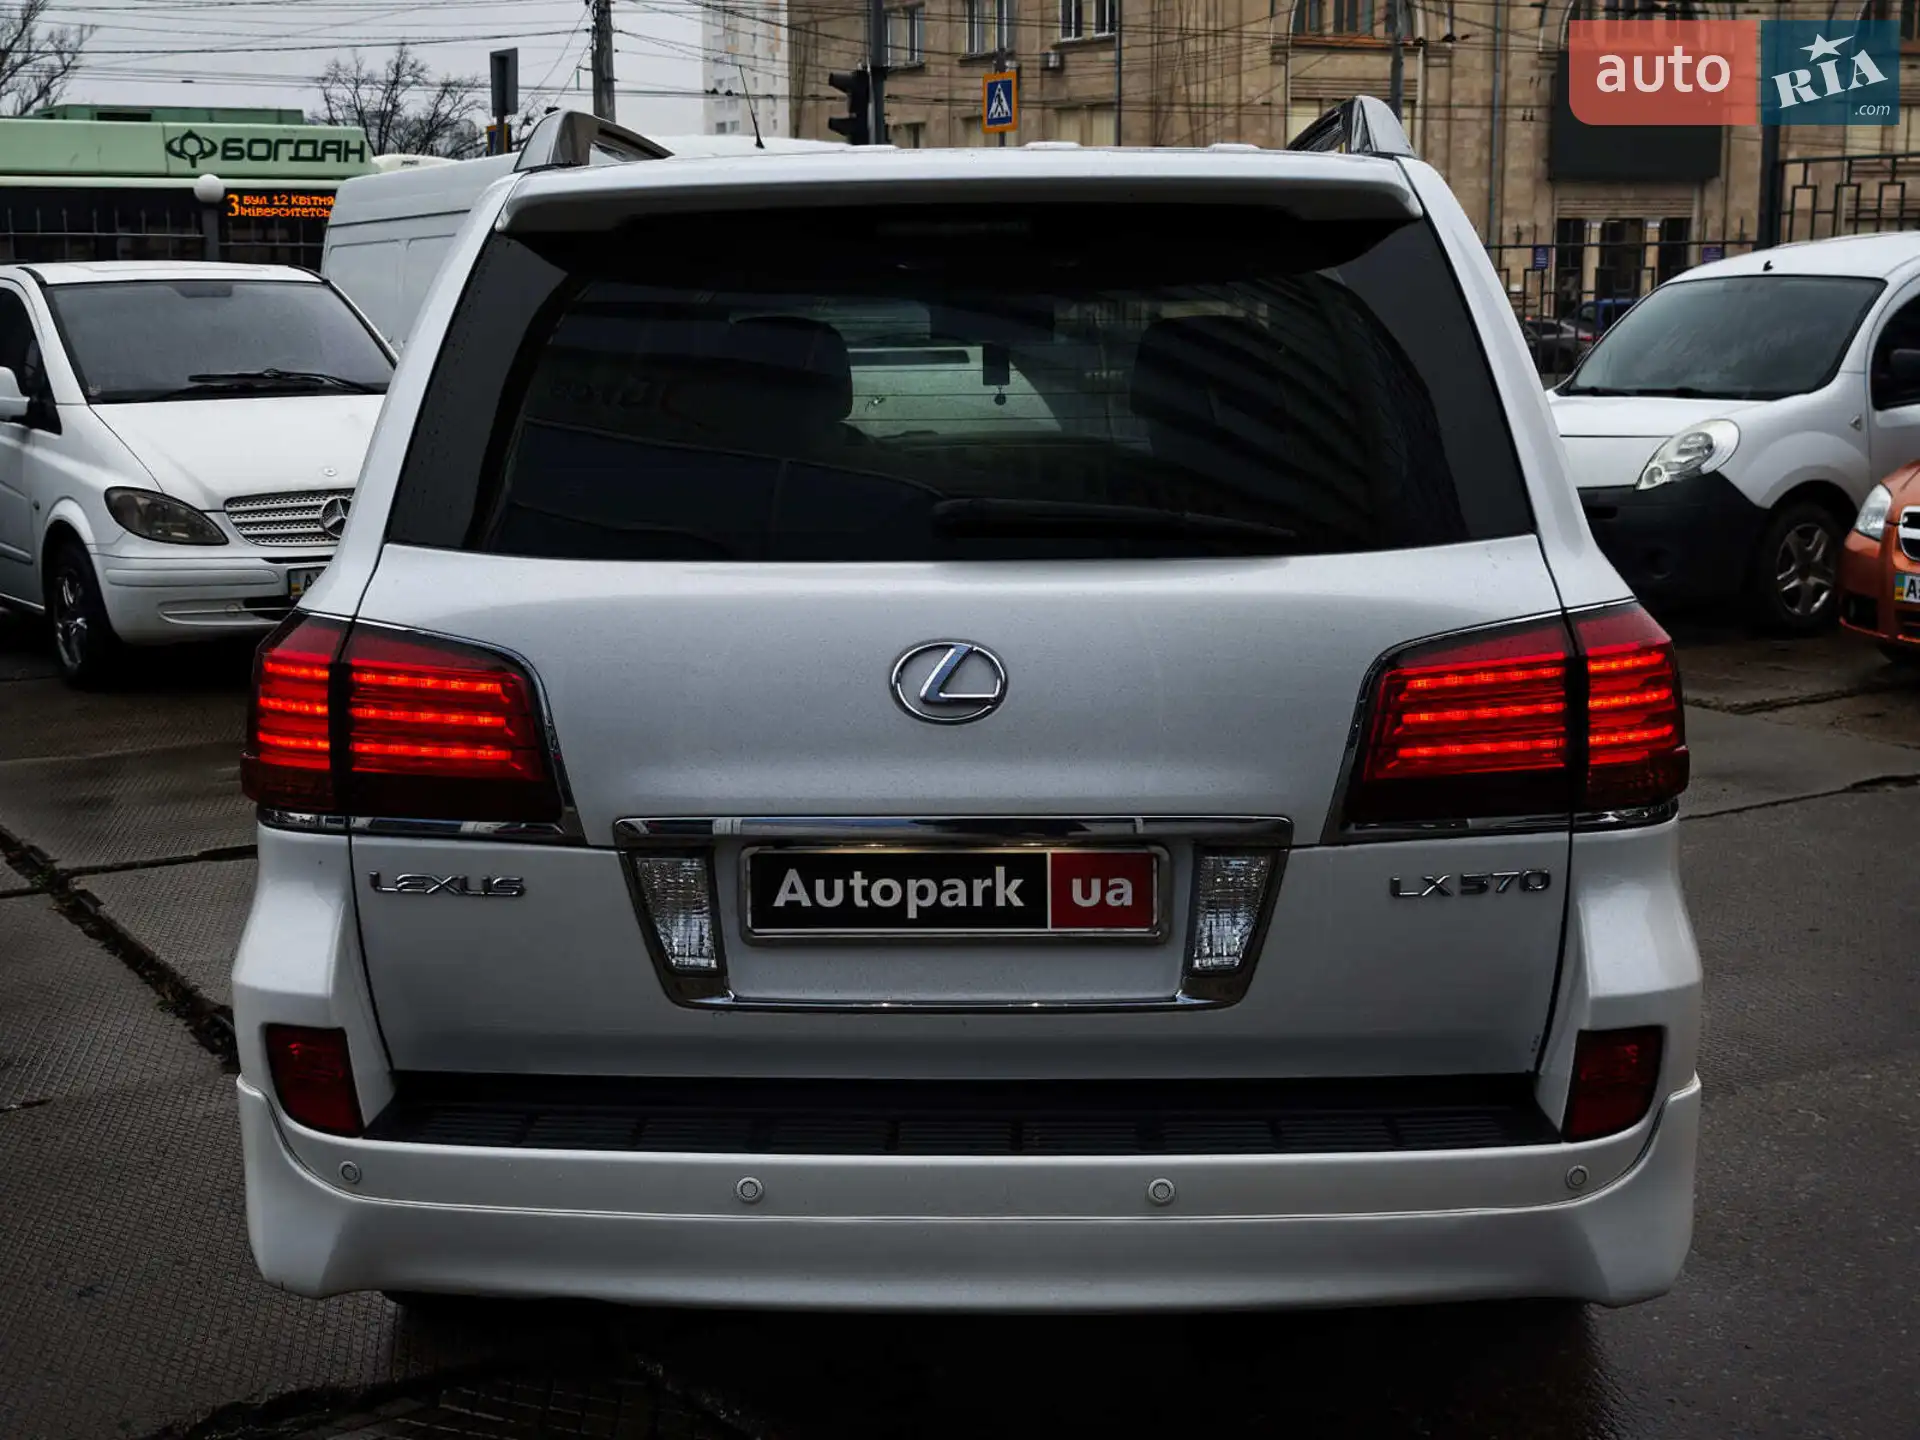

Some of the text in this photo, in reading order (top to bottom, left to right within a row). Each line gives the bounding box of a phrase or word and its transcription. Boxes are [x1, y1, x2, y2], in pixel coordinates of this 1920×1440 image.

[221, 138, 365, 162] БОГДАН
[227, 194, 239, 216] 3
[273, 194, 289, 205] 12
[369, 870, 526, 897] LEXUS
[773, 866, 1134, 919] Autopark ua
